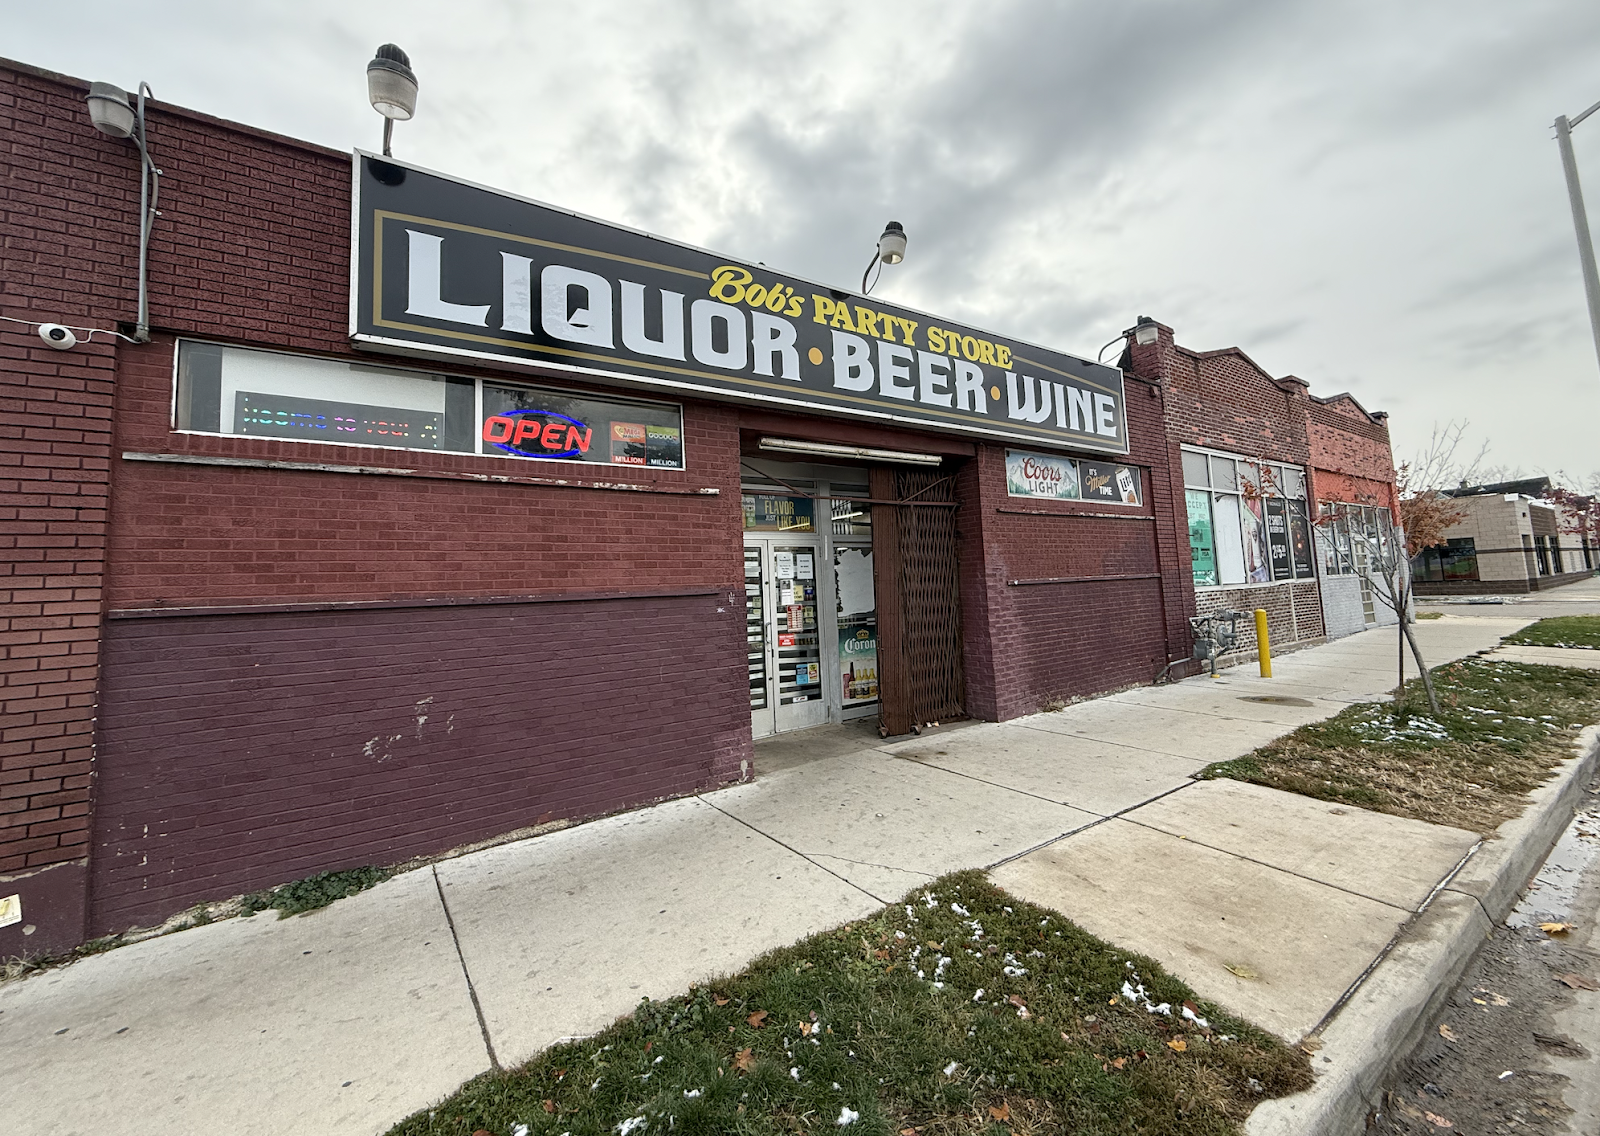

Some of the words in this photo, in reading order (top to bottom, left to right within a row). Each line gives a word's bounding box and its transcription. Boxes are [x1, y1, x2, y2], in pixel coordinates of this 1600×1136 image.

[708, 265, 806, 317] Bob's
[811, 293, 918, 347] PARTY
[926, 325, 1014, 370] STORE
[404, 228, 802, 381] LIQUOR
[830, 329, 988, 414] BEER
[1004, 370, 1118, 437] WINE
[482, 415, 593, 452] OPEN
[615, 456, 644, 464] MILLION
[1022, 457, 1062, 482] Coors
[1028, 480, 1059, 495] LIGHT
[1085, 474, 1111, 493] Miller
[1099, 485, 1113, 496] TIME
[764, 500, 795, 515] FLAVOR
[776, 515, 793, 530] LIKE
[795, 515, 811, 530] YOU
[844, 637, 877, 655] Coron
